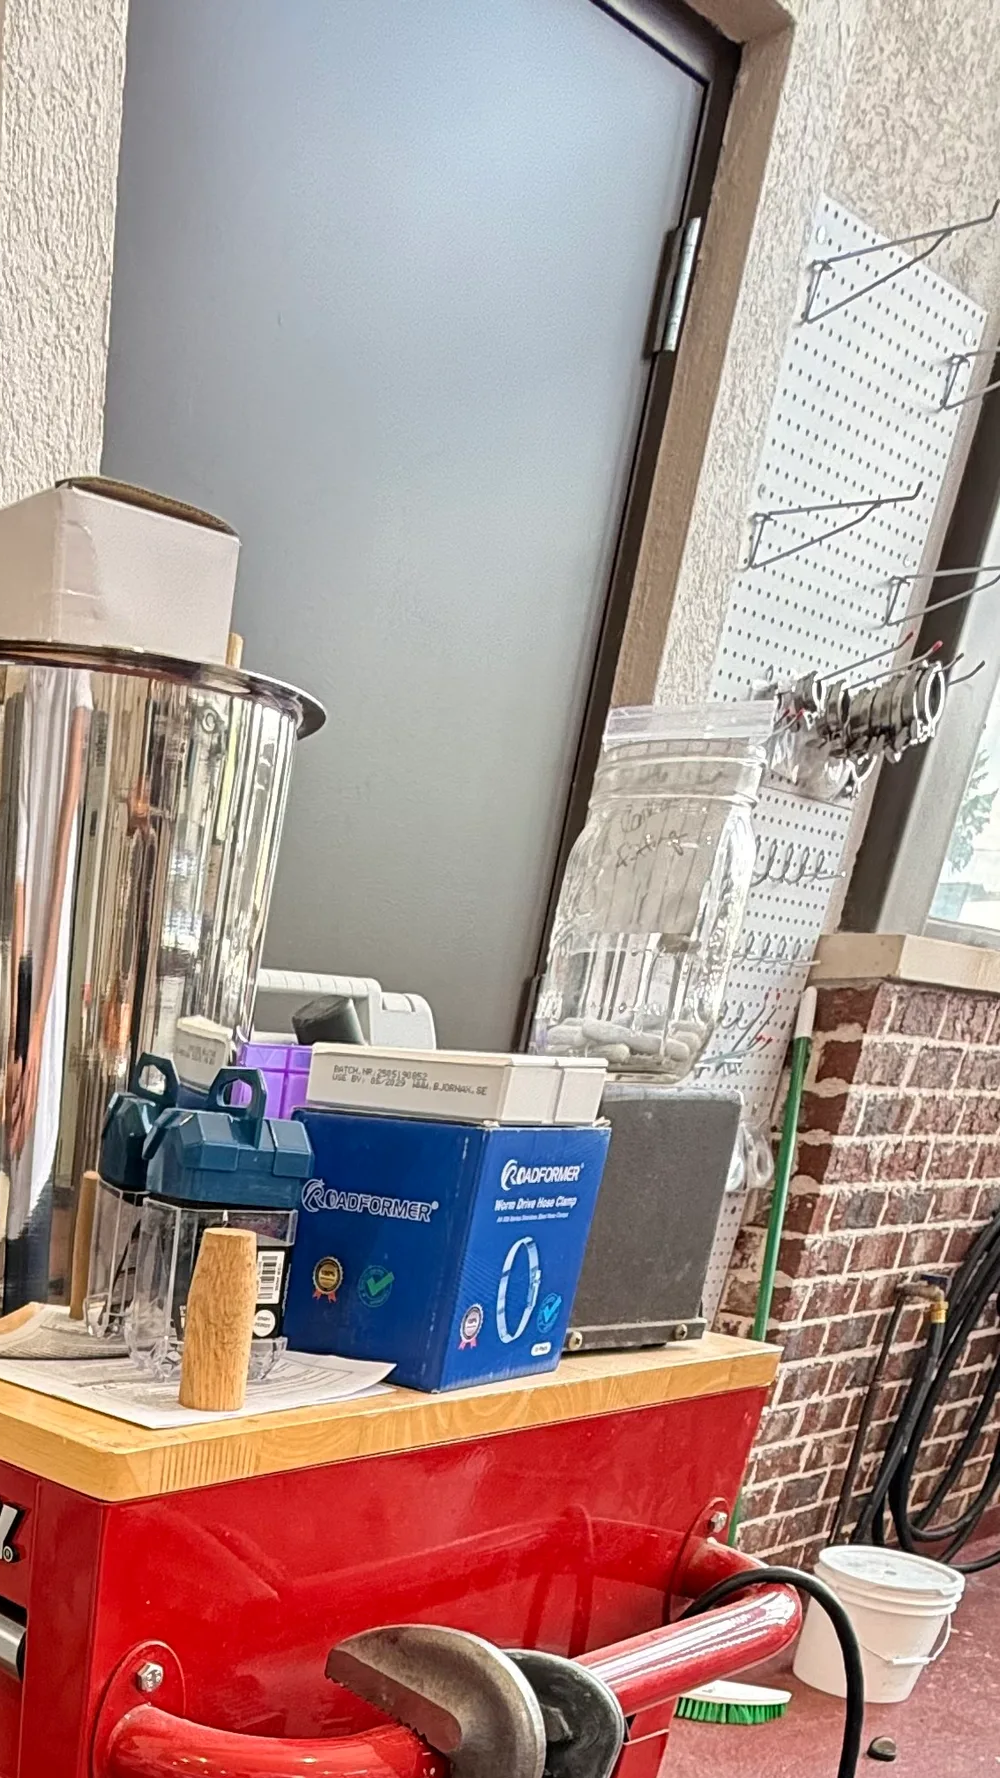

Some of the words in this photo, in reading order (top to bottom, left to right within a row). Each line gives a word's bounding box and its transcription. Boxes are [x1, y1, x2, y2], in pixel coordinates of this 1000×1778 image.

[501, 1159, 581, 1191] ROADFORMER
[301, 1179, 432, 1222] ROADFORMER
[494, 1199, 516, 1211] Worm
[516, 1197, 536, 1210] Drive
[536, 1197, 555, 1208] Hose
[555, 1195, 578, 1208] Clamp
